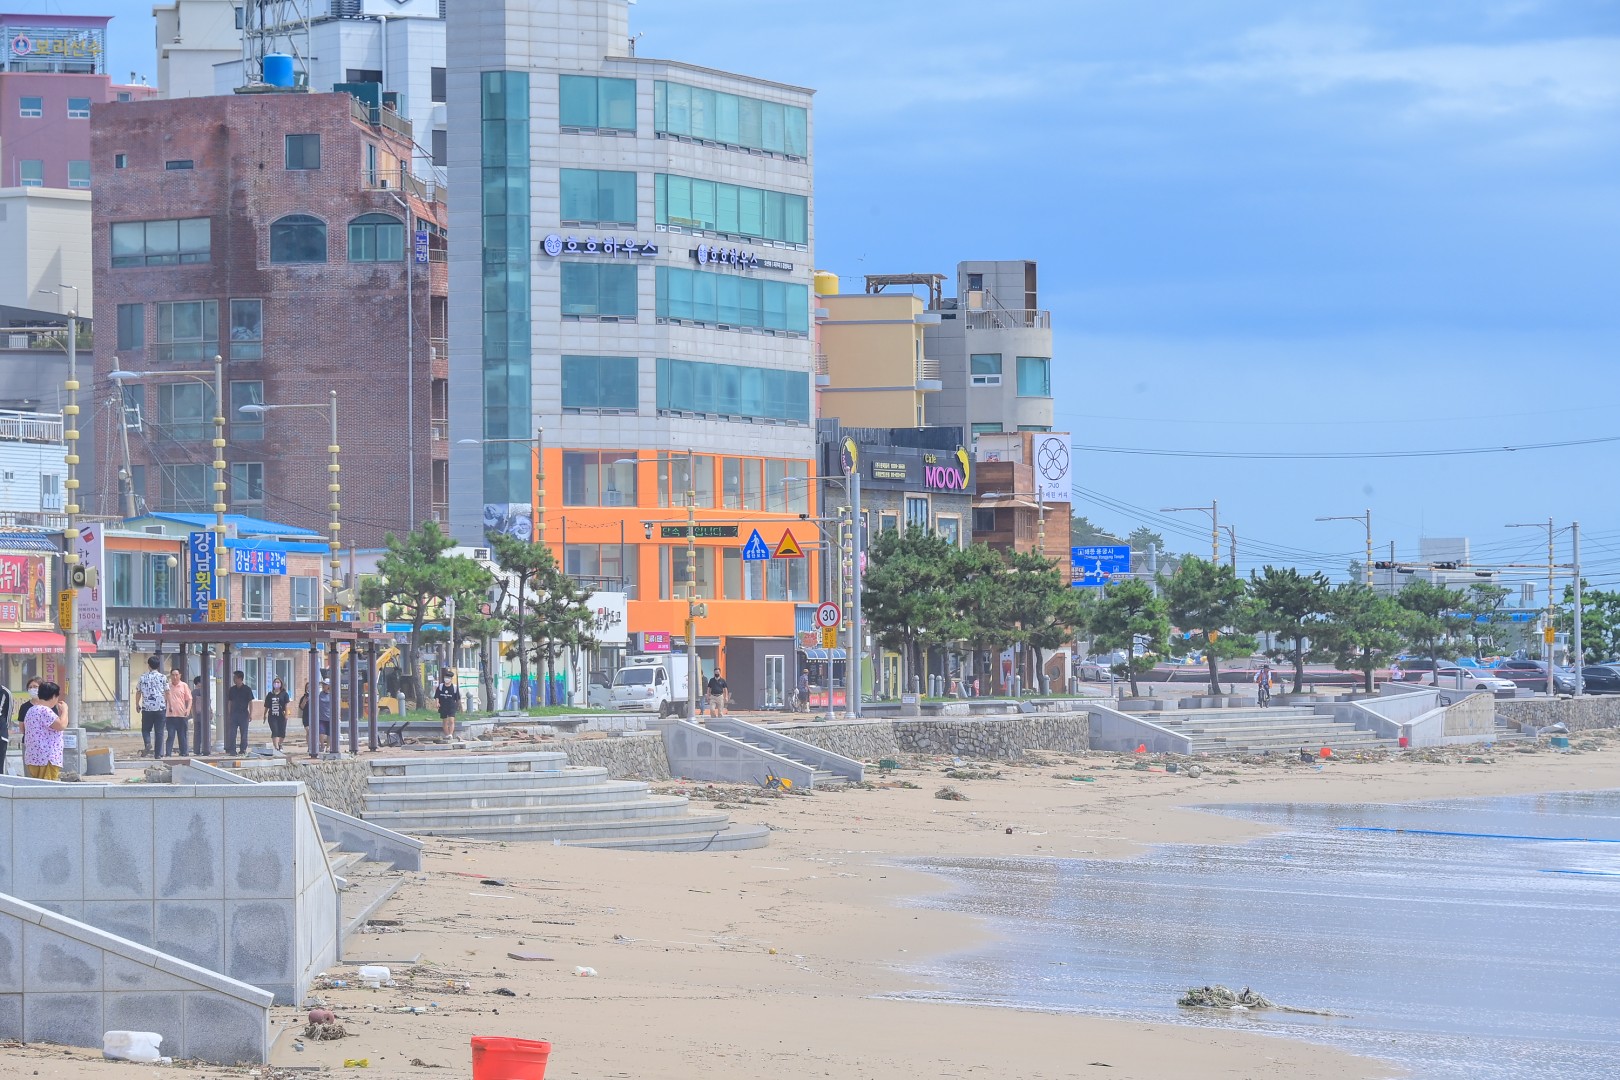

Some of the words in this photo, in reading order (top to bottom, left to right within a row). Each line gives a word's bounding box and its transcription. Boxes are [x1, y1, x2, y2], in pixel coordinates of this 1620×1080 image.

[563, 236, 658, 259] 호호하우스
[709, 246, 758, 270] 호호하우스
[925, 466, 964, 489] MOON
[662, 527, 681, 537] 단속
[194, 532, 212, 611] 강남횟집
[236, 550, 264, 572] 강남횟집
[822, 609, 836, 621] 30
[271, 697, 280, 717] RIDE
